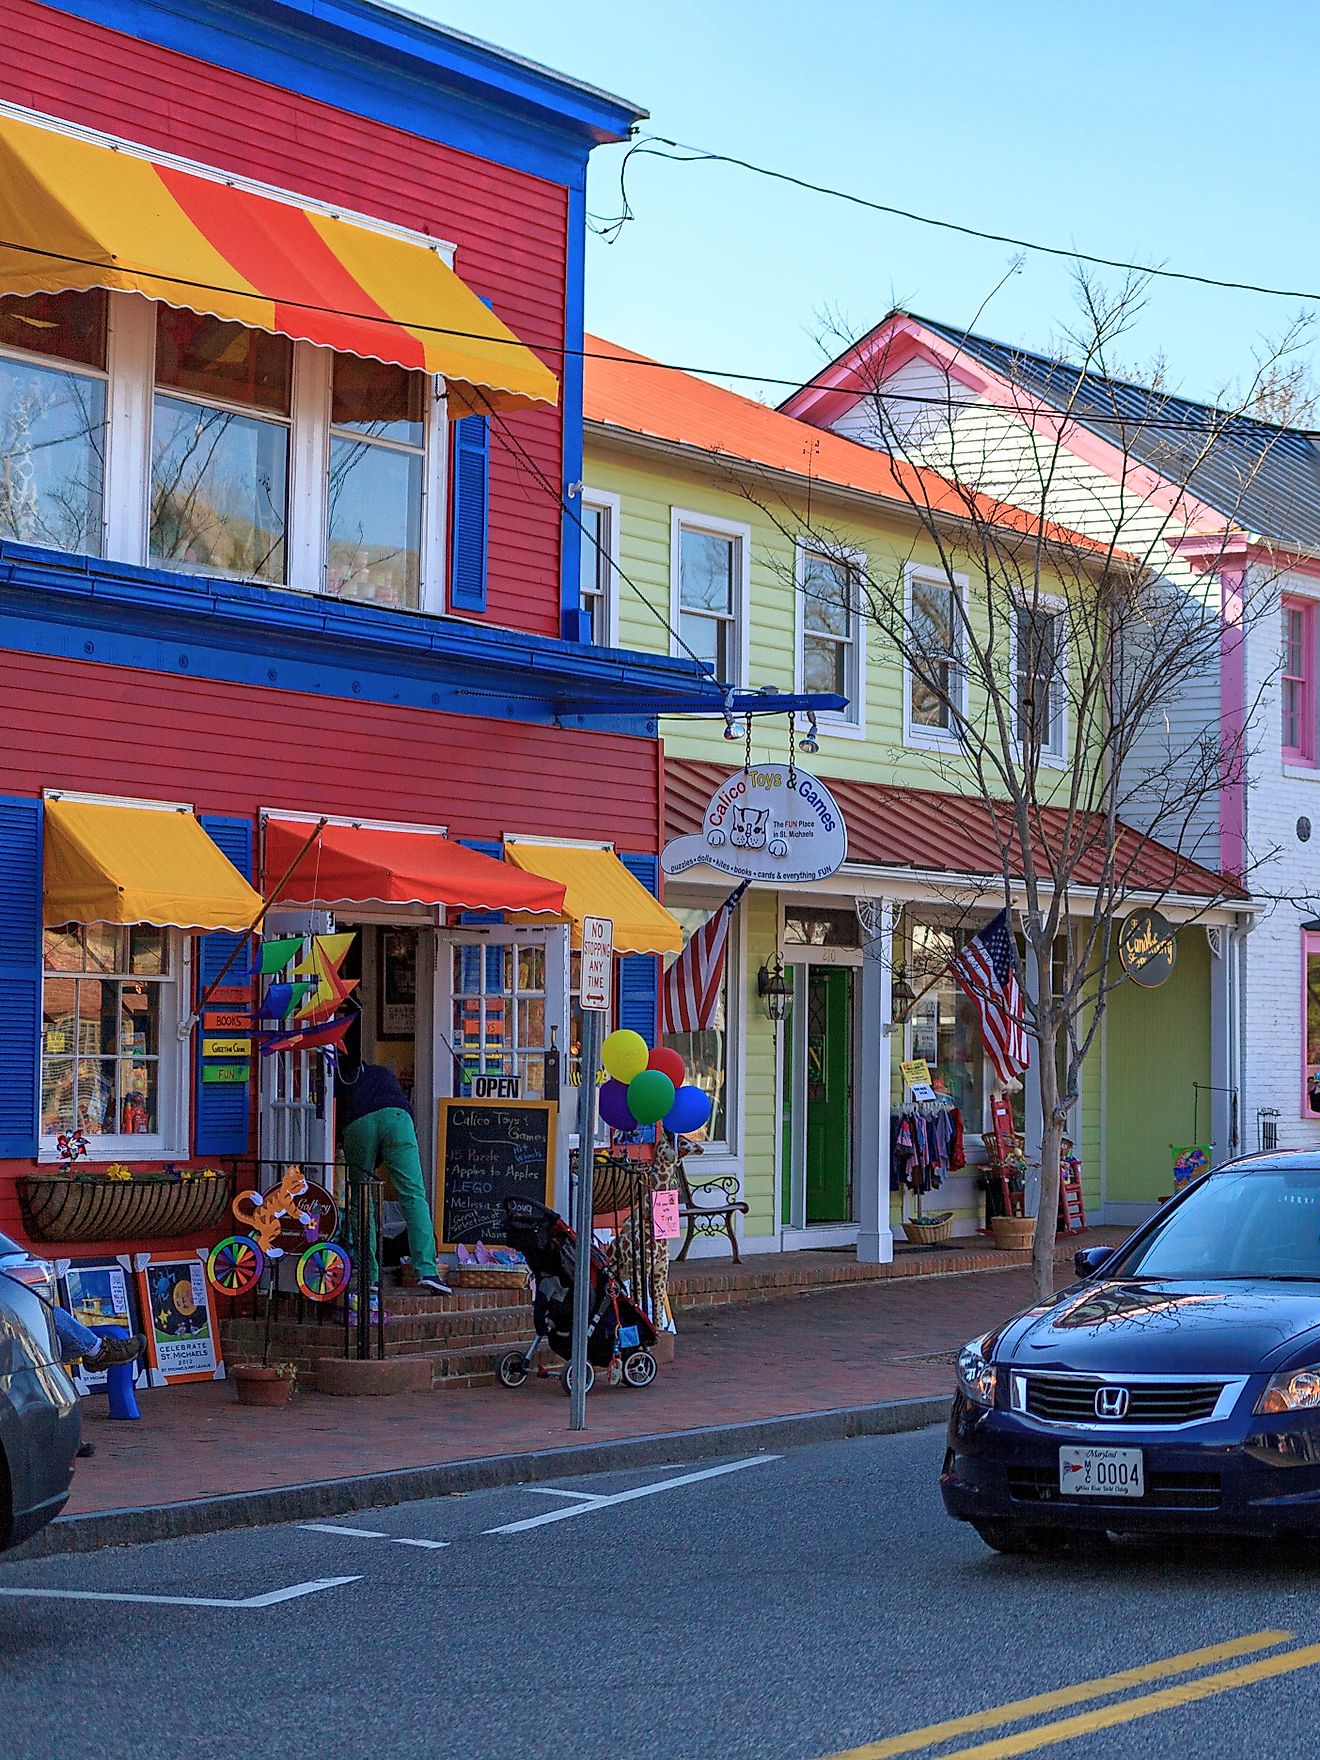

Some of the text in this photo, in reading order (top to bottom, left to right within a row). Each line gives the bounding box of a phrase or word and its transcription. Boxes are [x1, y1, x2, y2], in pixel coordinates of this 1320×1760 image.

[709, 770, 836, 832] Calico Toys & Games
[773, 820, 784, 828] The
[785, 820, 798, 828] FUN
[670, 857, 693, 873] puzzles
[697, 854, 713, 863] dolls
[716, 858, 730, 870] kites
[733, 867, 752, 877] books
[758, 871, 776, 880] cards
[783, 871, 816, 881] everything
[818, 864, 832, 878] FUN
[592, 923, 603, 938] NO
[585, 940, 610, 958] STOPPING
[589, 960, 603, 973] ANY
[588, 975, 604, 989] TIME
[216, 1016, 242, 1027] BOOKS
[218, 1069, 235, 1079] FUN
[475, 1077, 519, 1099] OPEN
[452, 1109, 491, 1127] Calico
[492, 1110, 520, 1131] Toys
[508, 1125, 546, 1144] Games
[468, 1149, 501, 1163] Puzzle
[451, 1164, 539, 1181] Apples to Apples
[452, 1180, 493, 1194] LEGO
[160, 1343, 207, 1353] CELEBRATE
[173, 1350, 208, 1359] MICHAELS
[1086, 1449, 1118, 1460] Maryland
[1097, 1462, 1139, 1486] 0004
